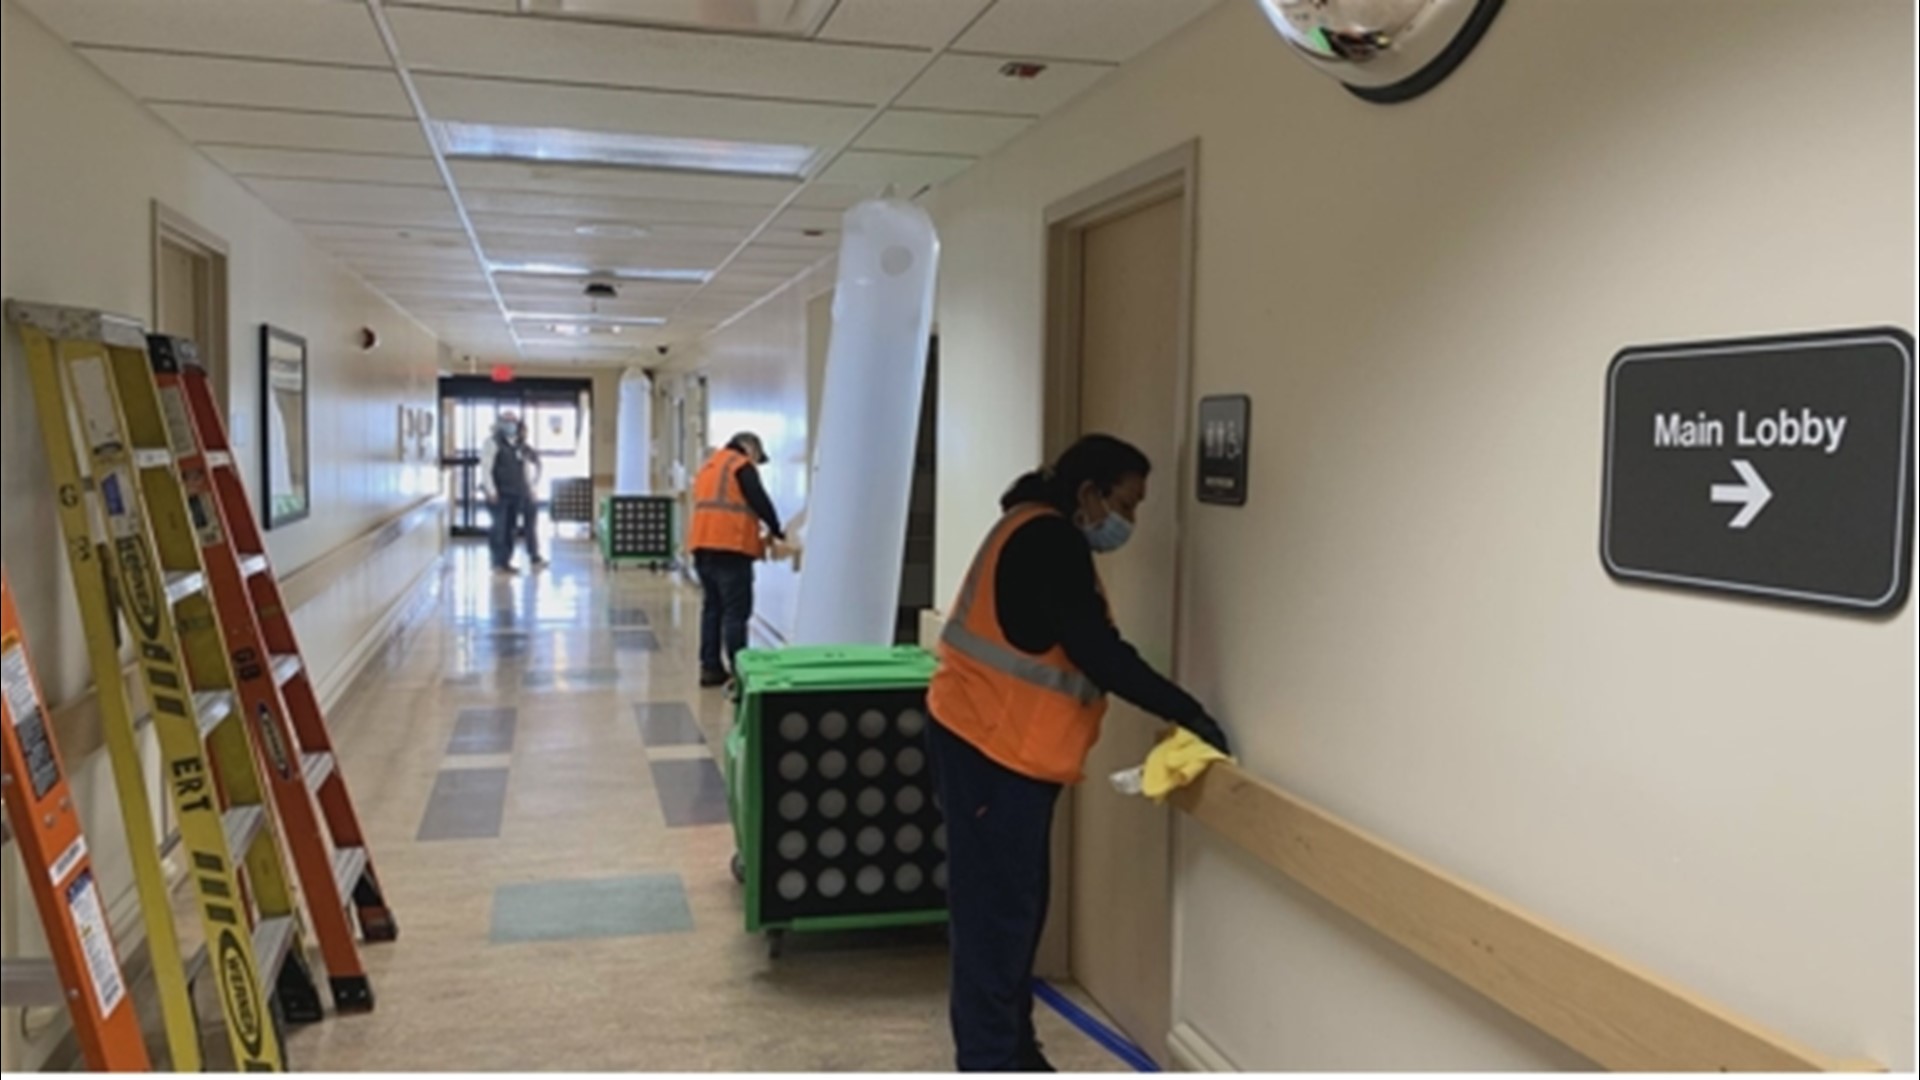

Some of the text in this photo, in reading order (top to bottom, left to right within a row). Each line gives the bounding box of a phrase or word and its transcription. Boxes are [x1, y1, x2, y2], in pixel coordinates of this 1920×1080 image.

[1654, 407, 1847, 454] Main Lobby
[171, 757, 214, 812] ERT
[227, 956, 257, 1036] WERNER
